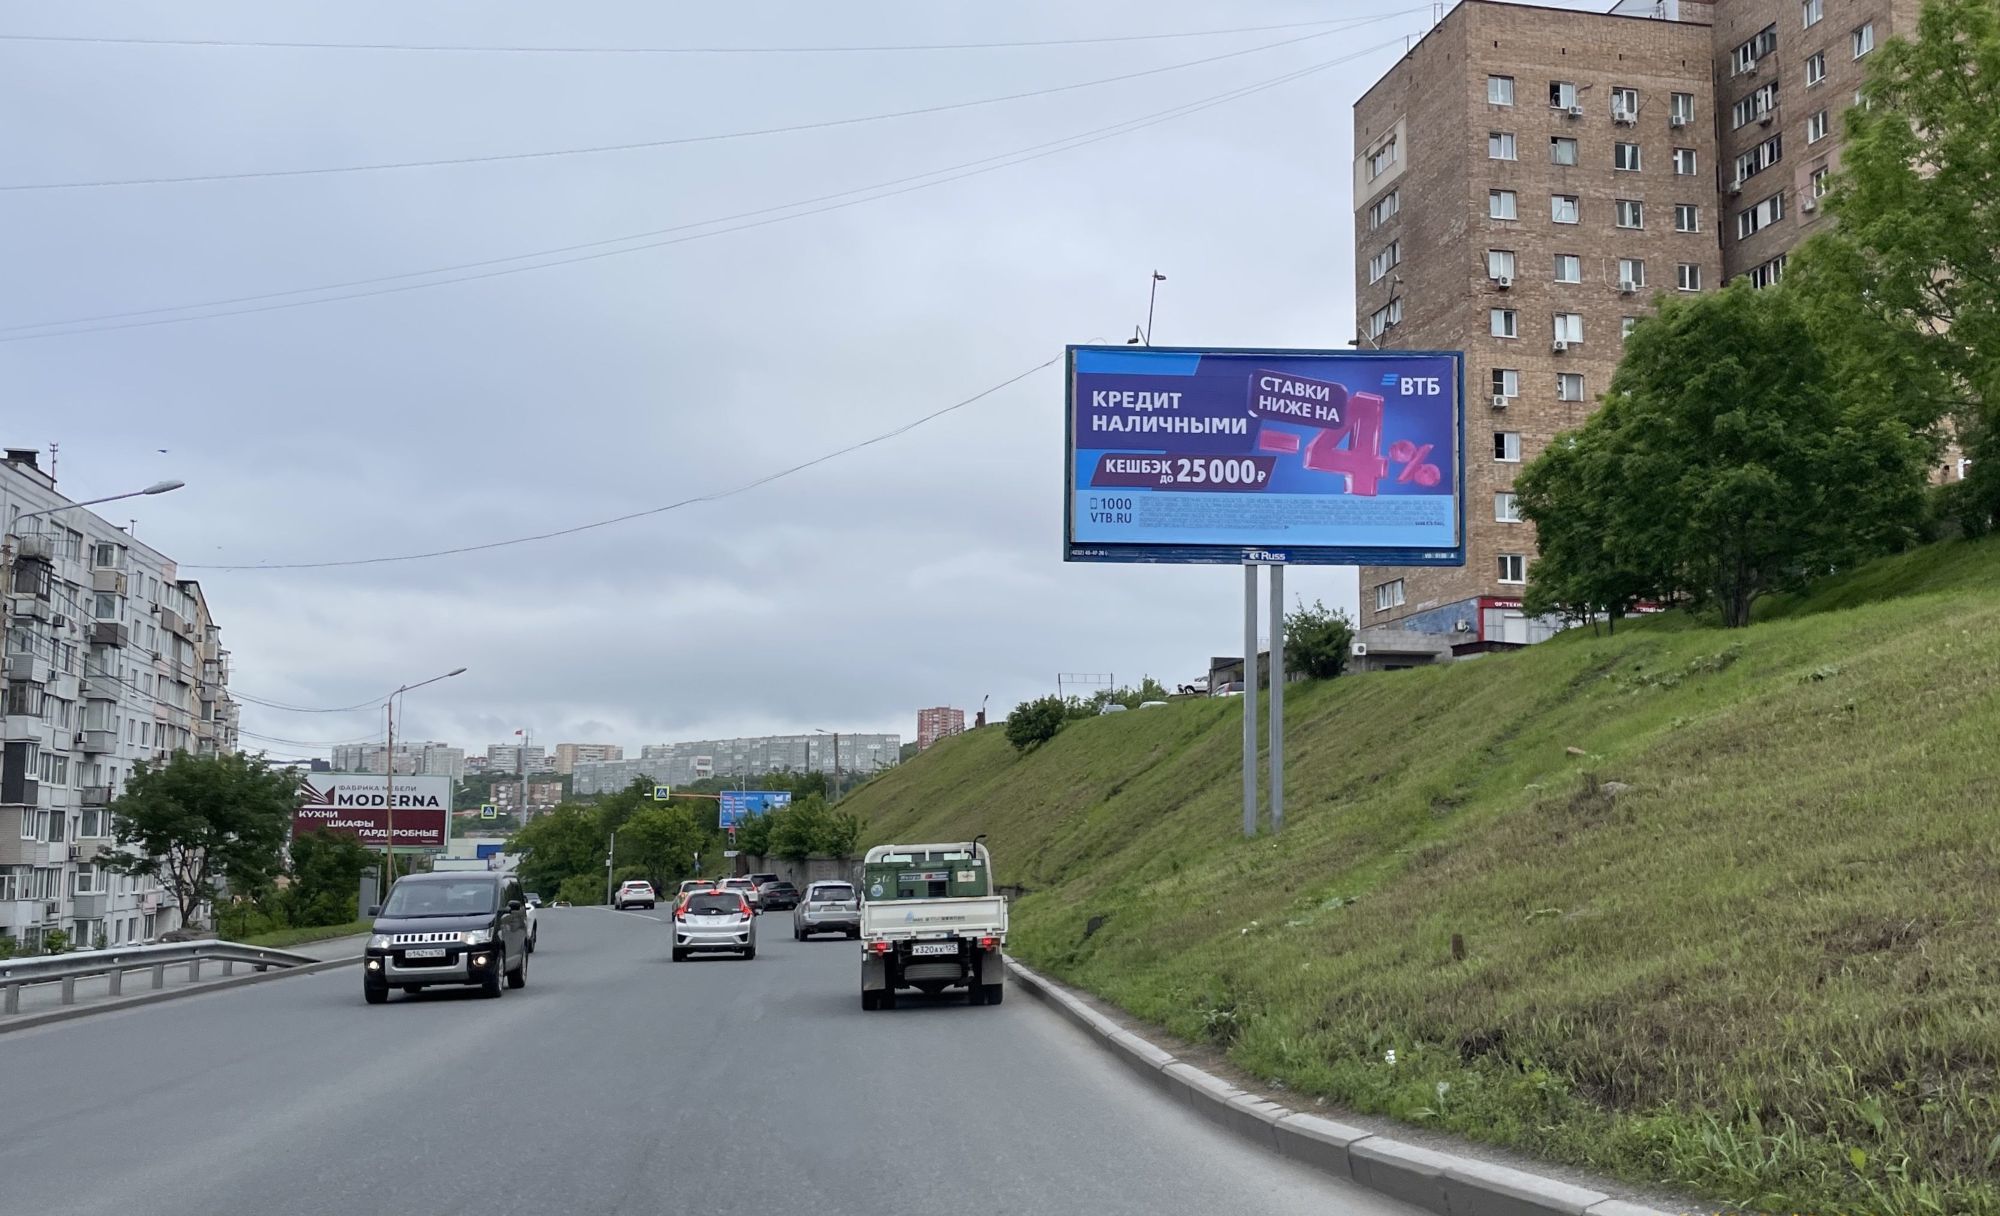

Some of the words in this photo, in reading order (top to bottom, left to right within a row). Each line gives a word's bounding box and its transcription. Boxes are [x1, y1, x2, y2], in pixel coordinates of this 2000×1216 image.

[1260, 376, 1330, 401] СТАВКИ
[1400, 377, 1440, 396] ВТБ
[1092, 390, 1182, 411] КРЕДИТ
[1258, 395, 1311, 418] НИЖЕ
[1315, 404, 1340, 423] НА
[1092, 415, 1247, 435] НАЛИЧНЫМИ
[1105, 459, 1172, 475] КЕШБЭК
[1100, 498, 1132, 510] 1000
[1090, 512, 1132, 524] VTB.RU
[1261, 550, 1286, 561] Russ
[338, 794, 439, 807] MODERNA
[299, 810, 338, 818] КУХНИ
[327, 819, 374, 828] ШКАФЫ
